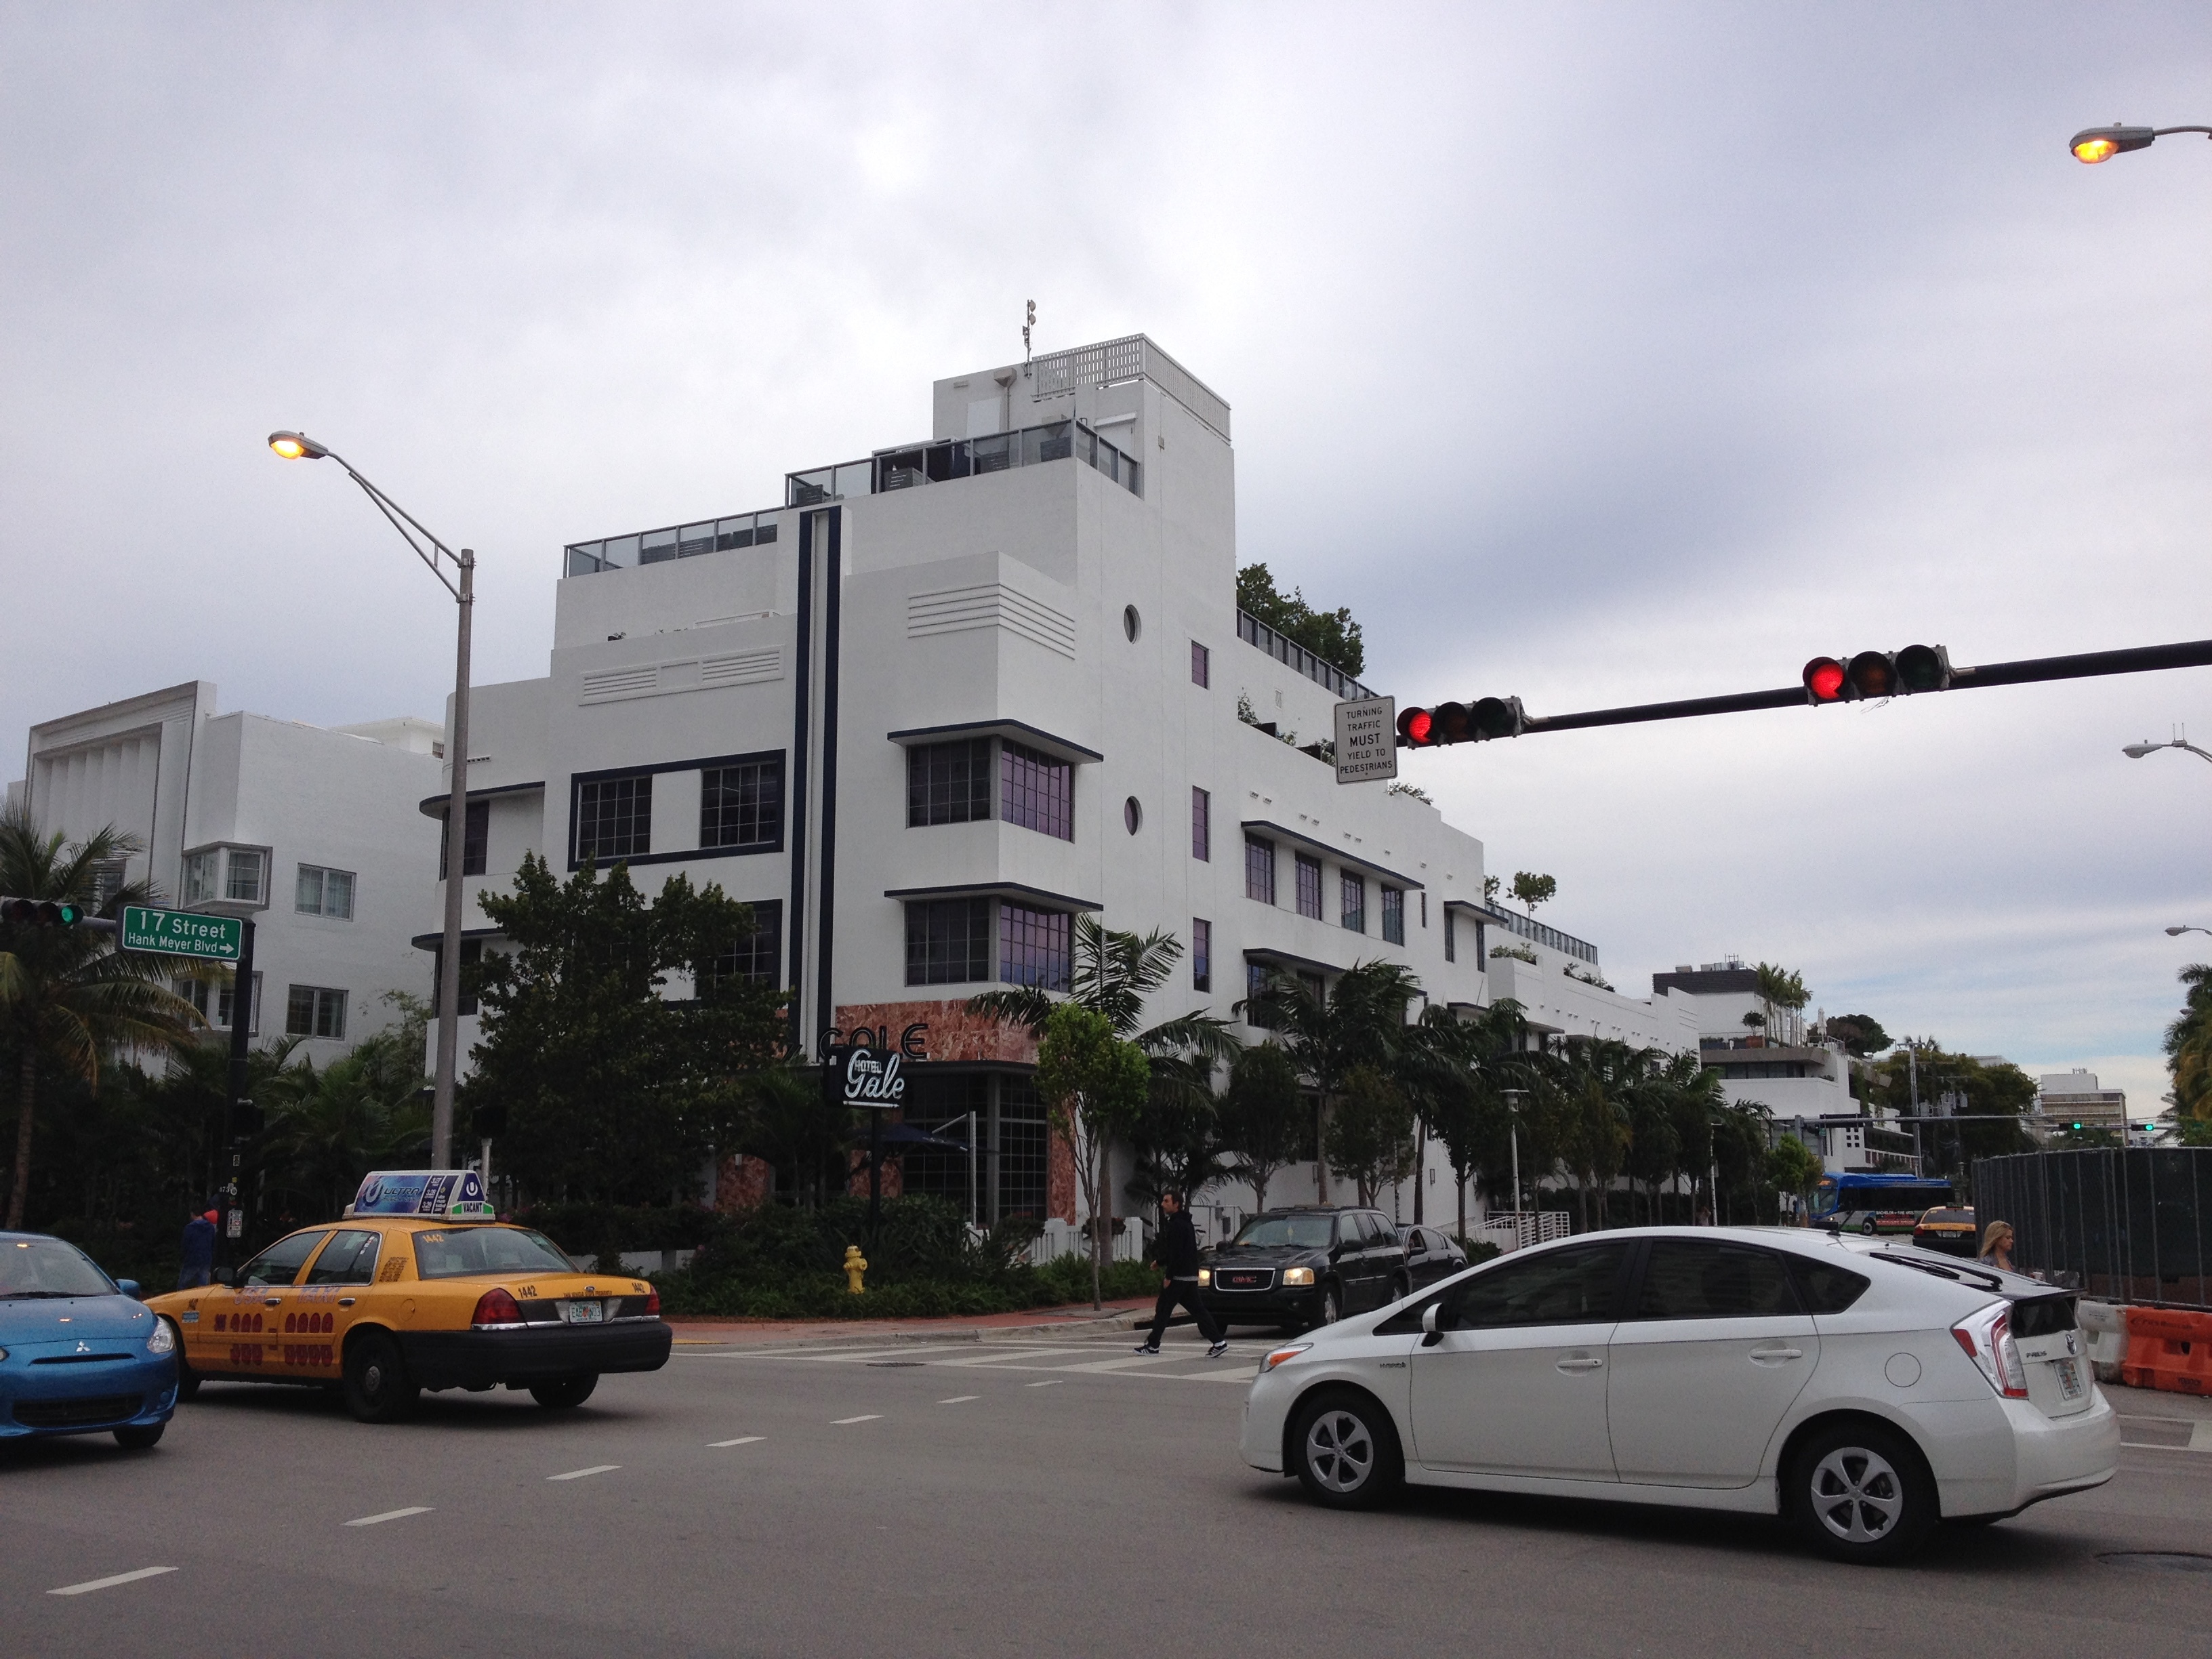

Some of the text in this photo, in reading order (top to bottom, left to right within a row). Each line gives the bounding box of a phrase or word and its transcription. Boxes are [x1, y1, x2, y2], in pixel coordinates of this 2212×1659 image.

[1347, 707, 1382, 719] TURNING
[1347, 720, 1380, 731] TRAFFIC
[1350, 733, 1380, 747] MUST
[1347, 748, 1385, 760] YIELD TO
[1340, 760, 1392, 774] PEDESTRIANS
[141, 911, 226, 939] 17 Street
[128, 932, 217, 953] Hank Meyer Blvd
[854, 1059, 883, 1073] HOTEL
[844, 1048, 905, 1099] Gale
[384, 1187, 420, 1195] ULTRA
[463, 1202, 482, 1212] VACANT
[423, 1234, 445, 1243] 1442
[518, 1285, 537, 1298] 1442
